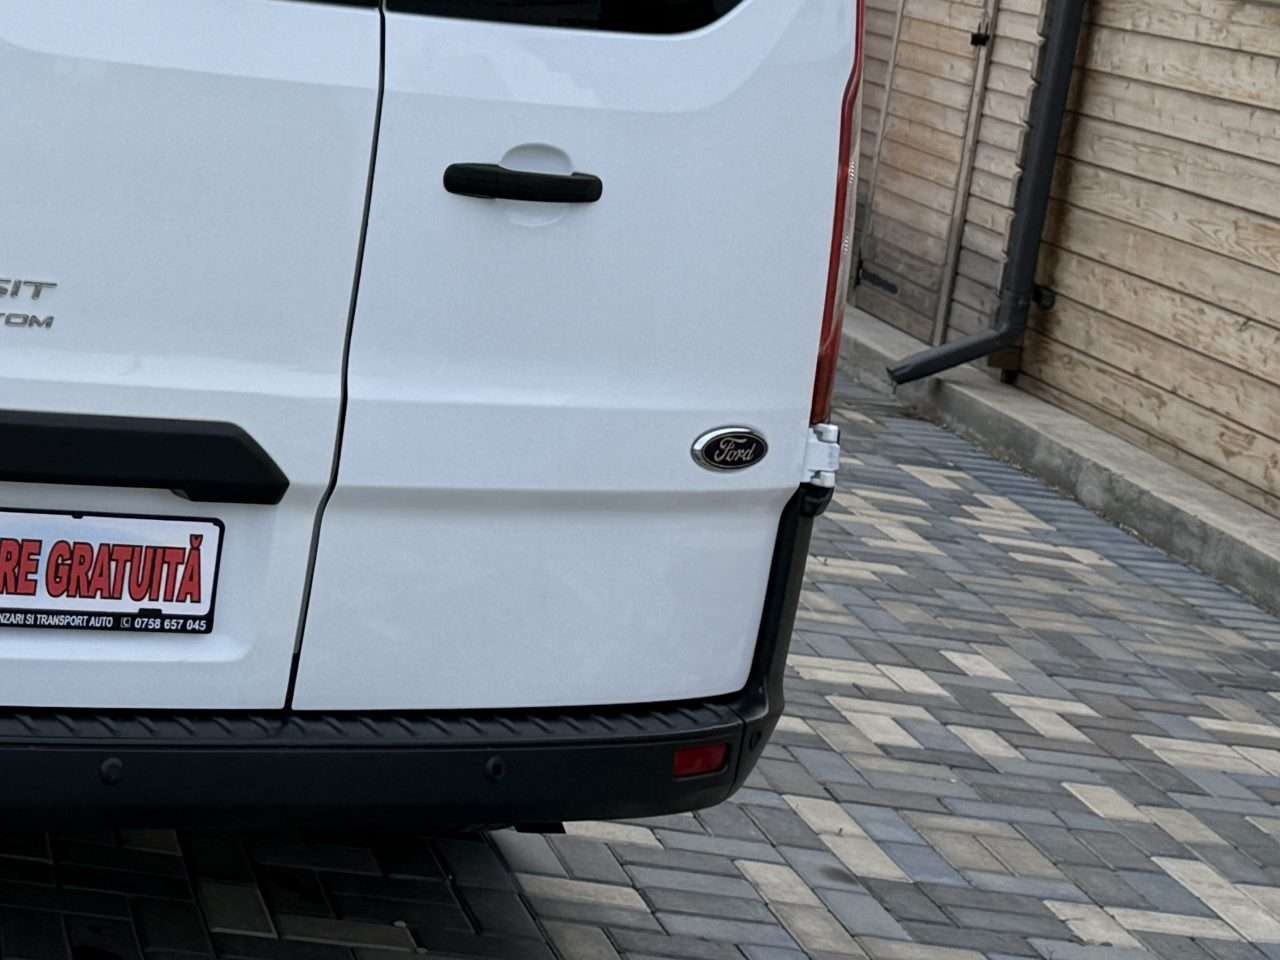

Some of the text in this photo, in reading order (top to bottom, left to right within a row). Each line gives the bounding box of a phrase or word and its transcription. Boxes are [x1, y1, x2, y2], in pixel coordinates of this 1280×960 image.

[713, 437, 756, 462] Ford
[45, 533, 204, 603] GRATUITĂ
[25, 614, 35, 625] SI
[36, 614, 88, 627] TRANSPORT
[89, 616, 113, 628] AUTO
[134, 618, 161, 629] 0758
[164, 619, 184, 630] 657
[186, 620, 207, 631] 045
